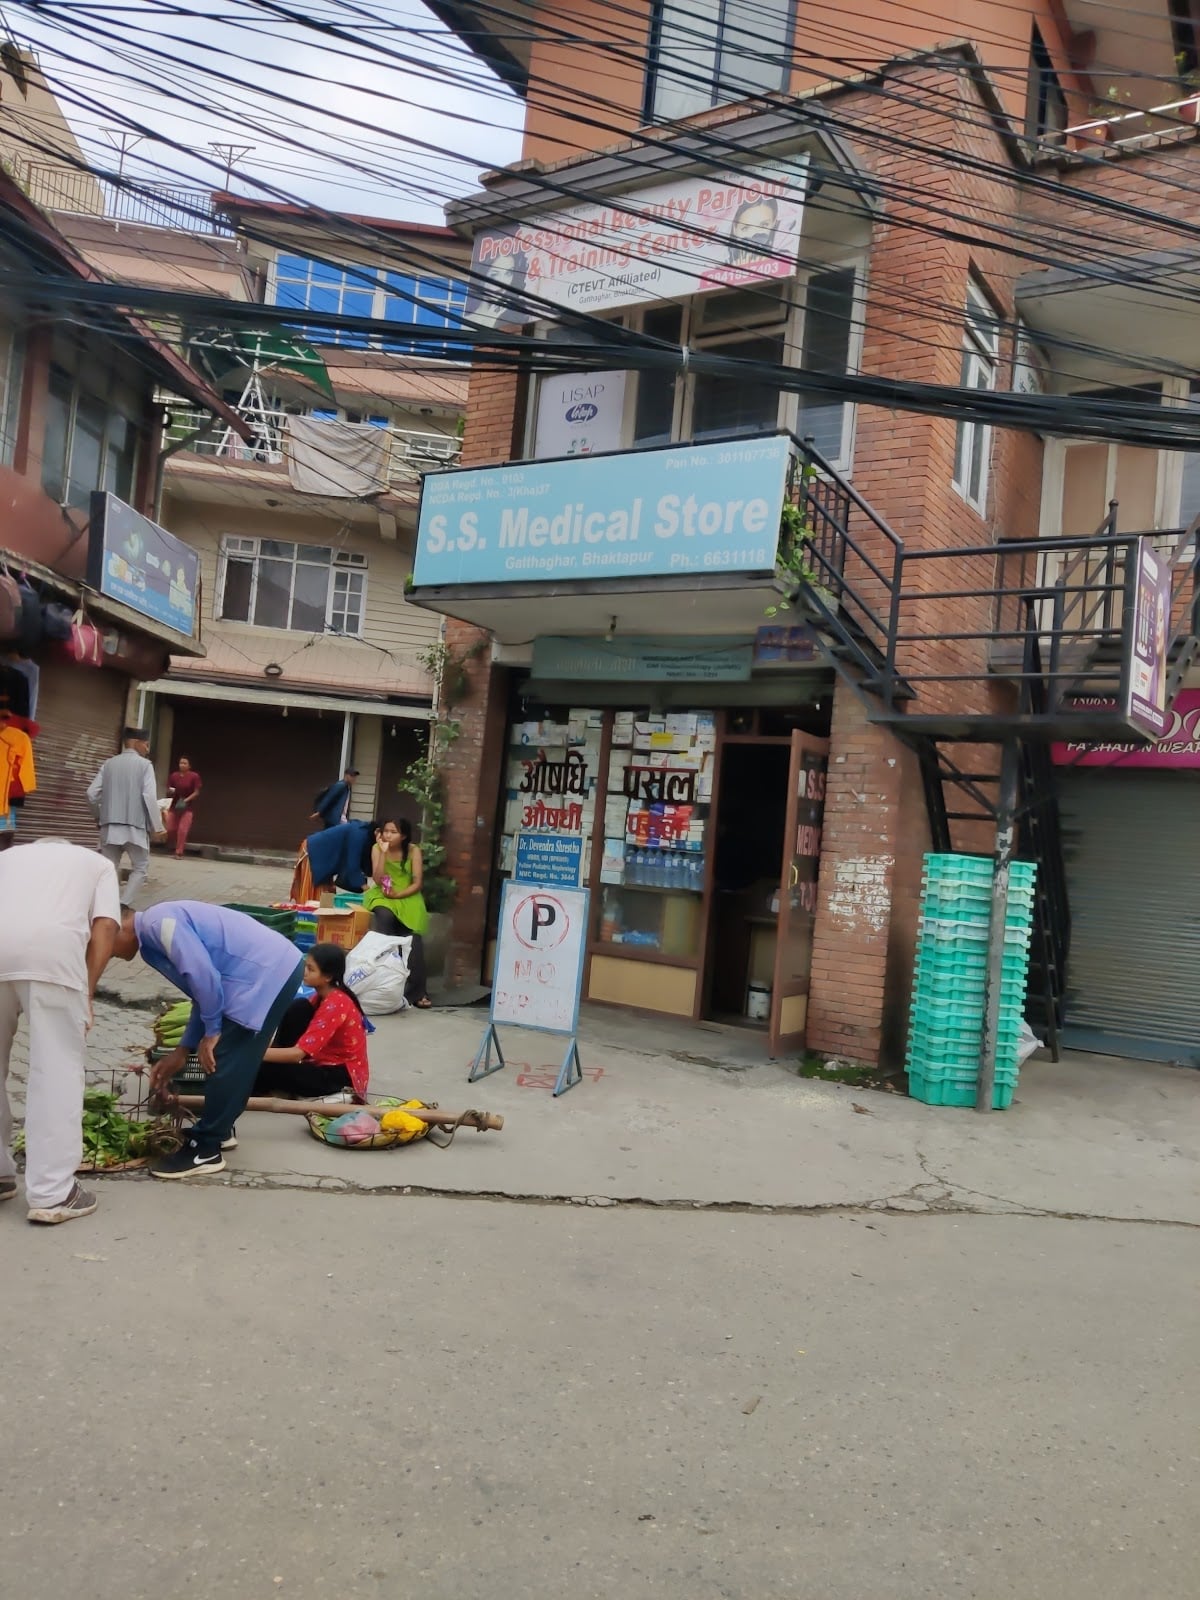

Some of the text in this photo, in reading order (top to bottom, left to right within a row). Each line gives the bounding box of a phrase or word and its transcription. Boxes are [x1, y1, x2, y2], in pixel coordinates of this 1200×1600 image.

[478, 211, 607, 262] Professional
[611, 197, 692, 233] Beauty
[696, 175, 790, 213] Parlour
[527, 225, 718, 282] & Training Center
[567, 268, 662, 298] (CTEVT Affiliated)
[561, 384, 605, 404] LISAP
[426, 493, 769, 554] S.S. Medical Store
[582, 551, 654, 567] Bhaktapur
[623, 765, 699, 801] पसल
[519, 838, 580, 854] Dr. Devendra Shrestha
[530, 903, 556, 941] P
